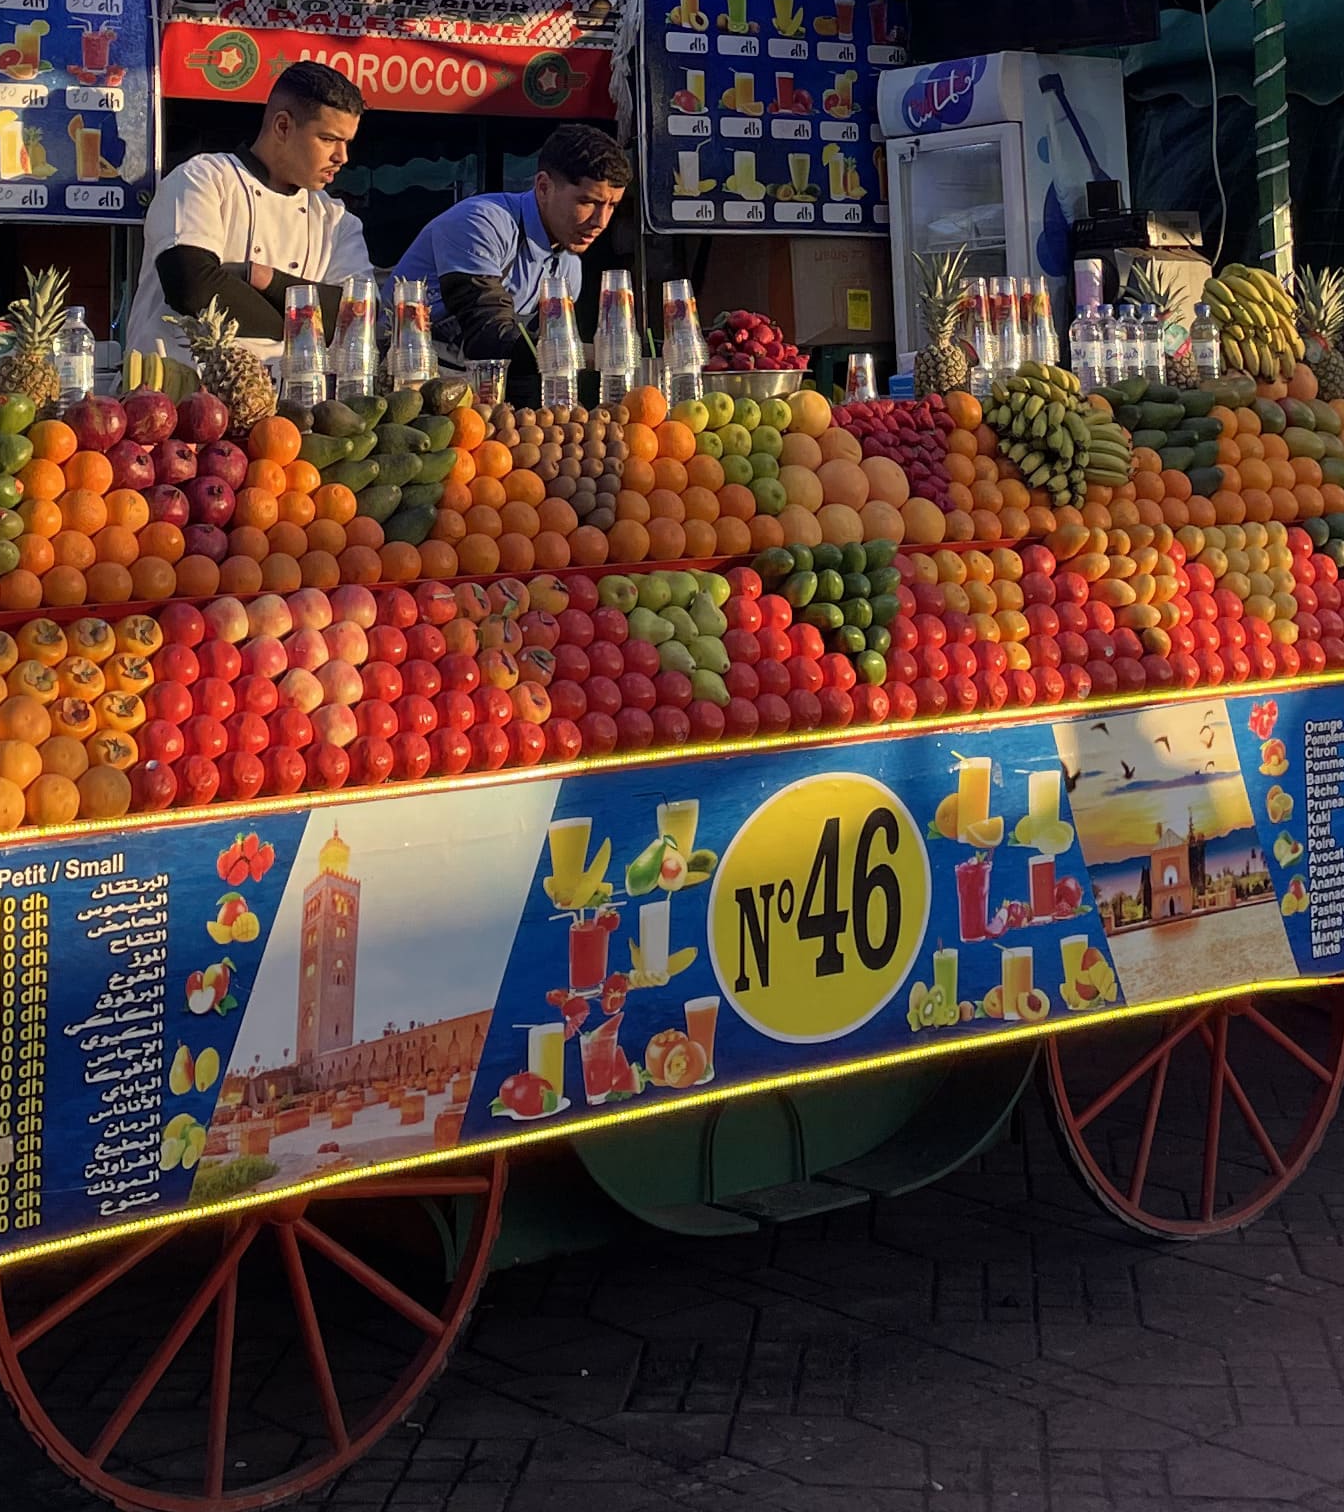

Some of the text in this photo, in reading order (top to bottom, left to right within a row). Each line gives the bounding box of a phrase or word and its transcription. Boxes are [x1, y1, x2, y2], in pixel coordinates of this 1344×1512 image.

[346, 1, 425, 20] THE
[267, 8, 527, 38] PALESTINE
[689, 38, 706, 52] dh
[98, 93, 121, 109] dh
[21, 189, 45, 206] dh
[98, 191, 121, 207] dh
[845, 206, 860, 222] dh
[1305, 719, 1343, 734] Orange
[1305, 745, 1338, 760] Citron
[1305, 758, 1344, 773] Pomme
[1306, 784, 1339, 799] Pêche
[1307, 810, 1331, 825] Kaki
[1307, 823, 1331, 838] Kiwi
[1308, 837, 1336, 852] Poire
[1308, 847, 1344, 865] Avocat
[64, 853, 125, 880] Small
[91, 873, 169, 899] البرتقال
[22, 892, 49, 912] dh
[1311, 915, 1343, 931] Fraise
[109, 928, 167, 954] التفاح
[127, 946, 166, 968] الموز
[1312, 943, 1341, 959] Mixte
[108, 965, 165, 991] الخوخ
[95, 984, 165, 1010] البرقوق
[103, 1112, 161, 1138] الرمان
[84, 1150, 160, 1179] الفراولة
[14, 1209, 41, 1229] dh
